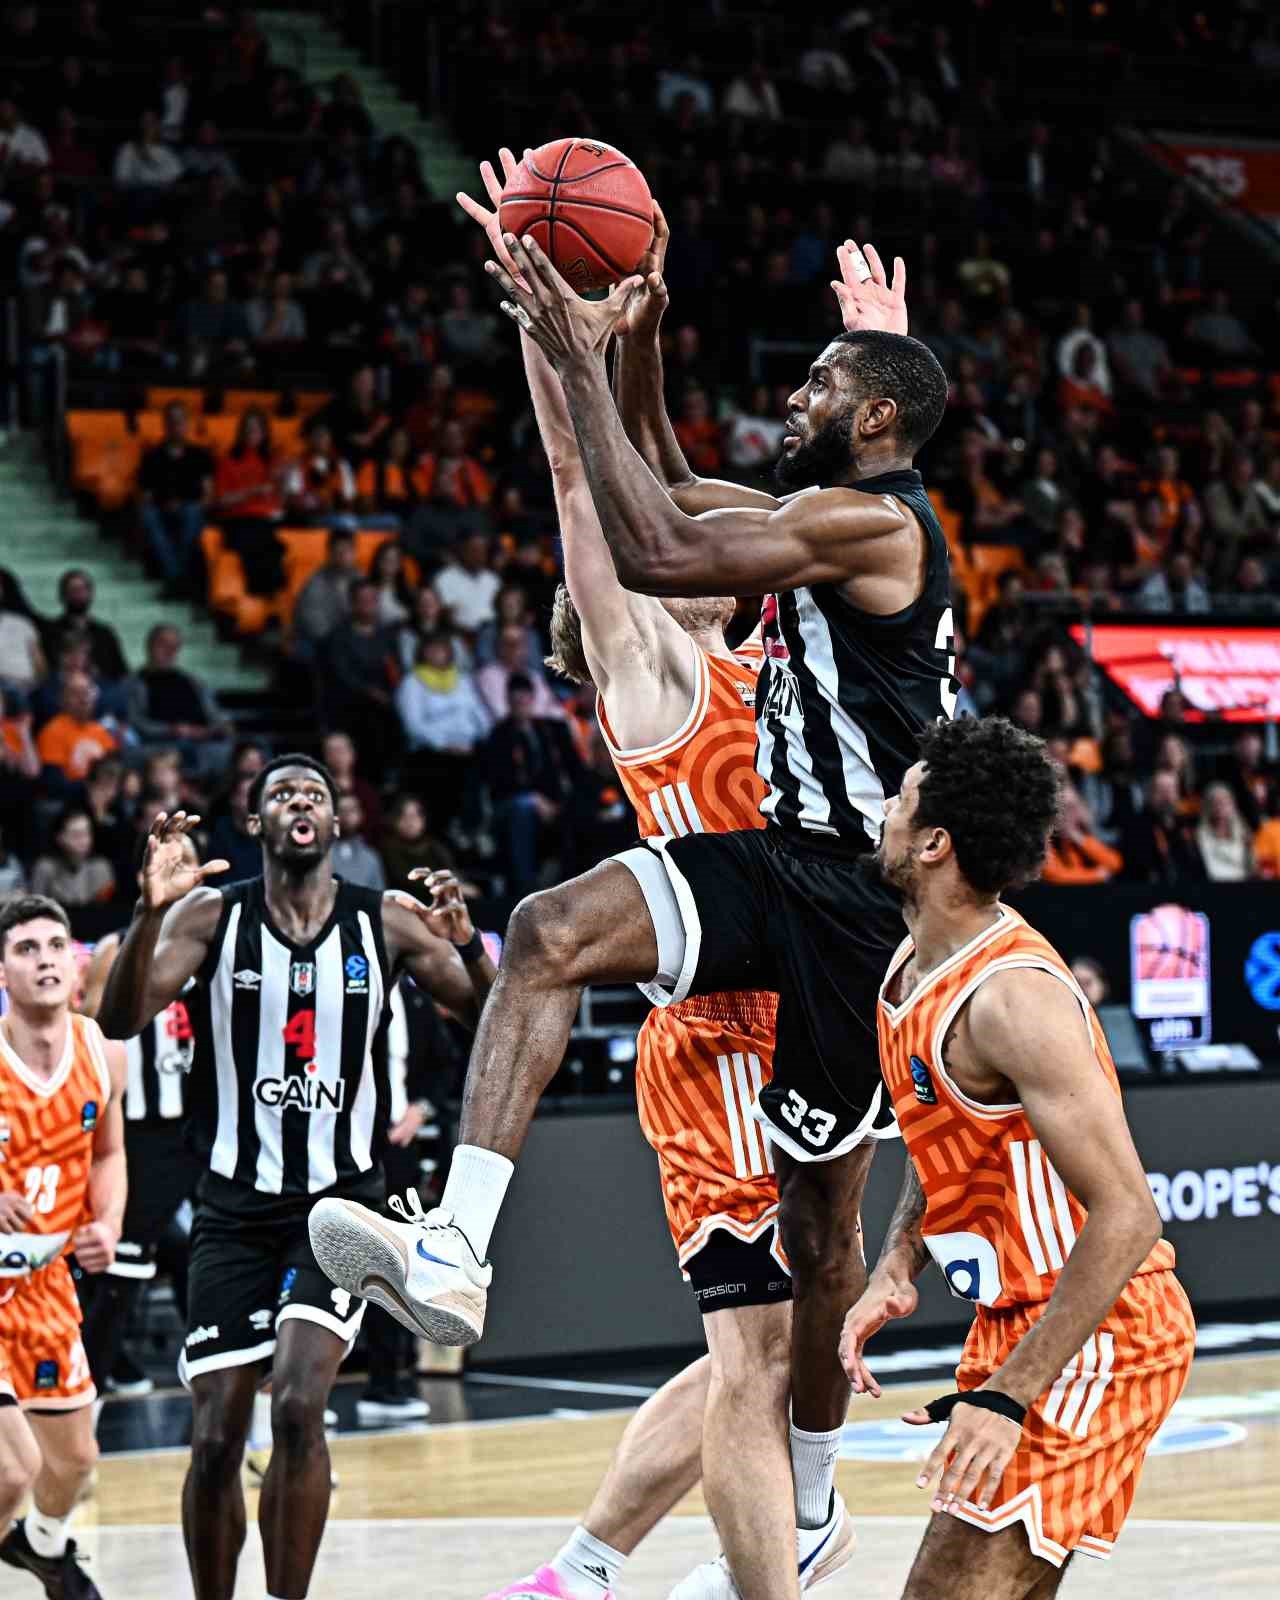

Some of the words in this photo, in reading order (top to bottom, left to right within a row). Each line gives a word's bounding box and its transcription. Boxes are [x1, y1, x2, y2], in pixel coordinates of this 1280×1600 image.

[282, 1008, 317, 1059] 4
[253, 1062, 344, 1112] GAIN
[780, 1088, 837, 1147] 33
[25, 1164, 61, 1214] 23
[694, 1283, 746, 1300] ression
